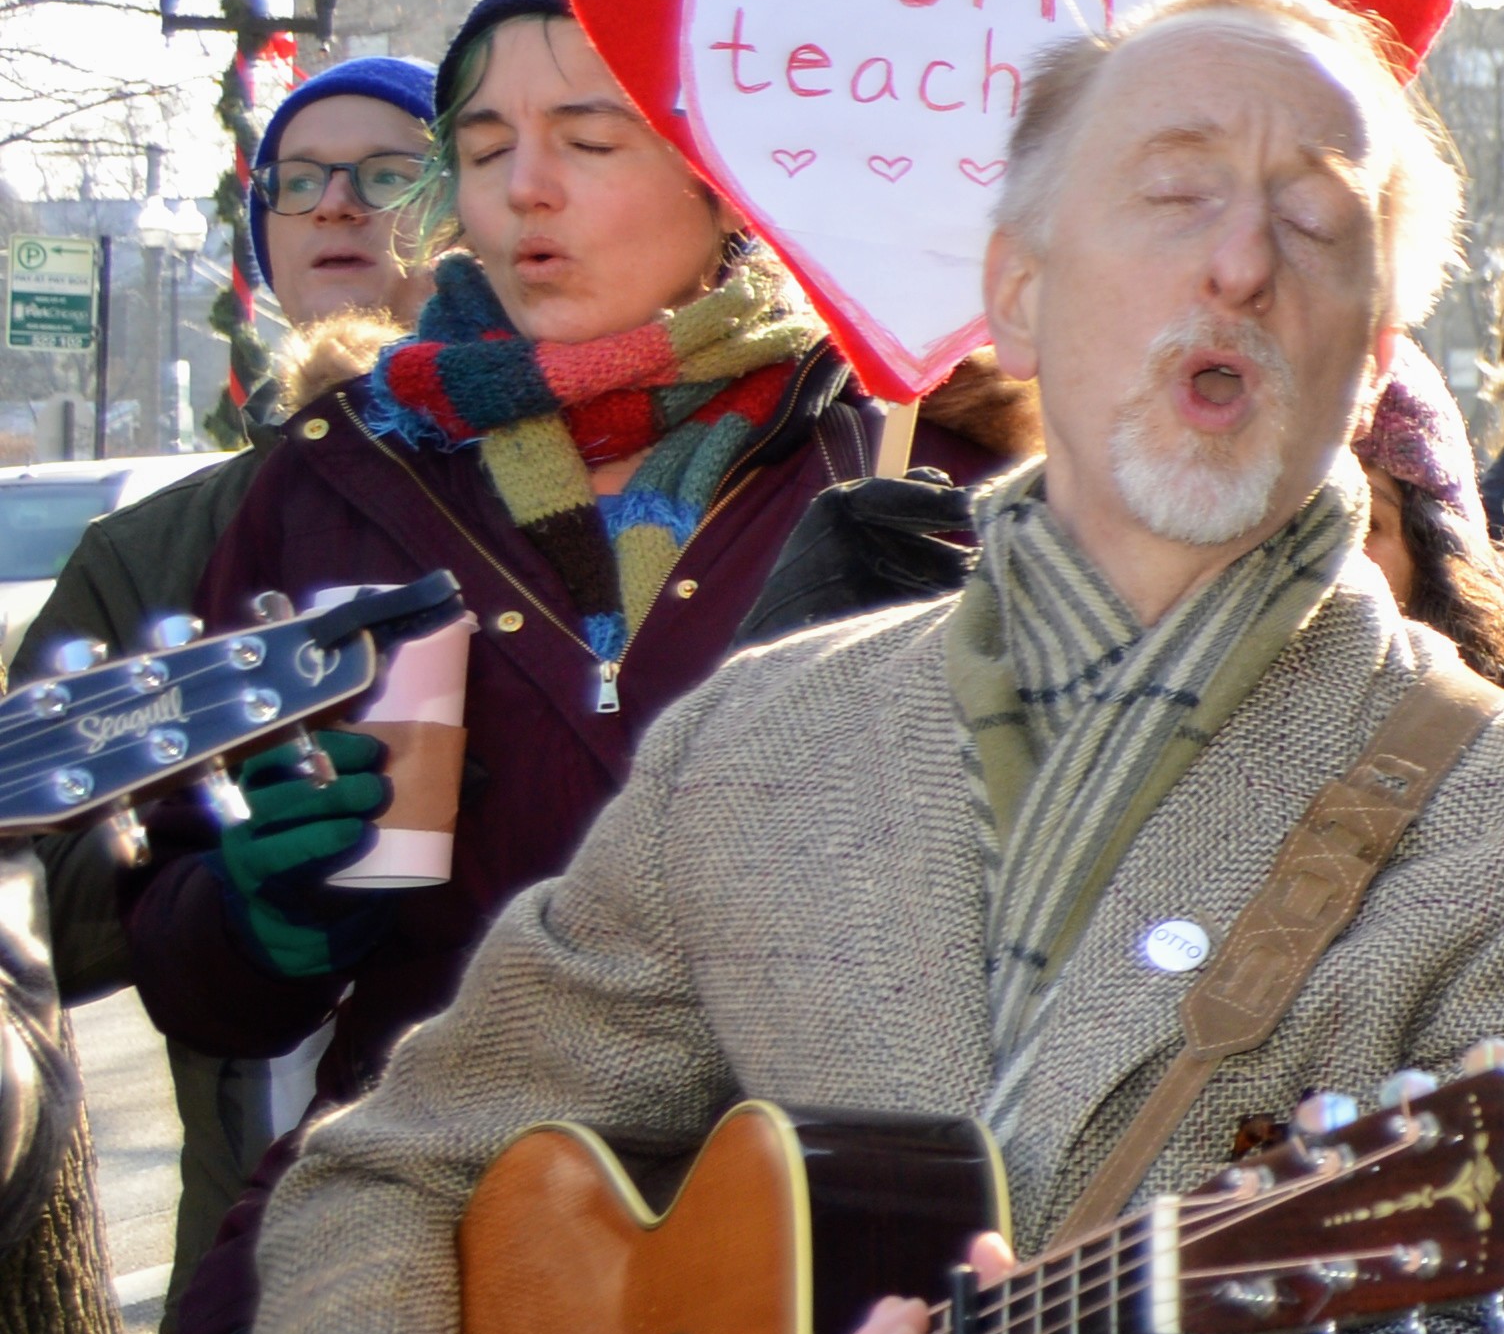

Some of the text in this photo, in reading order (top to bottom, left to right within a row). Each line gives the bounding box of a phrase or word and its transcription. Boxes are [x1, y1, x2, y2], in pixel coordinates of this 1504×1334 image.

[710, 9, 1022, 116] teach
[77, 685, 191, 754] Seagull
[1154, 928, 1202, 959] OTTO
